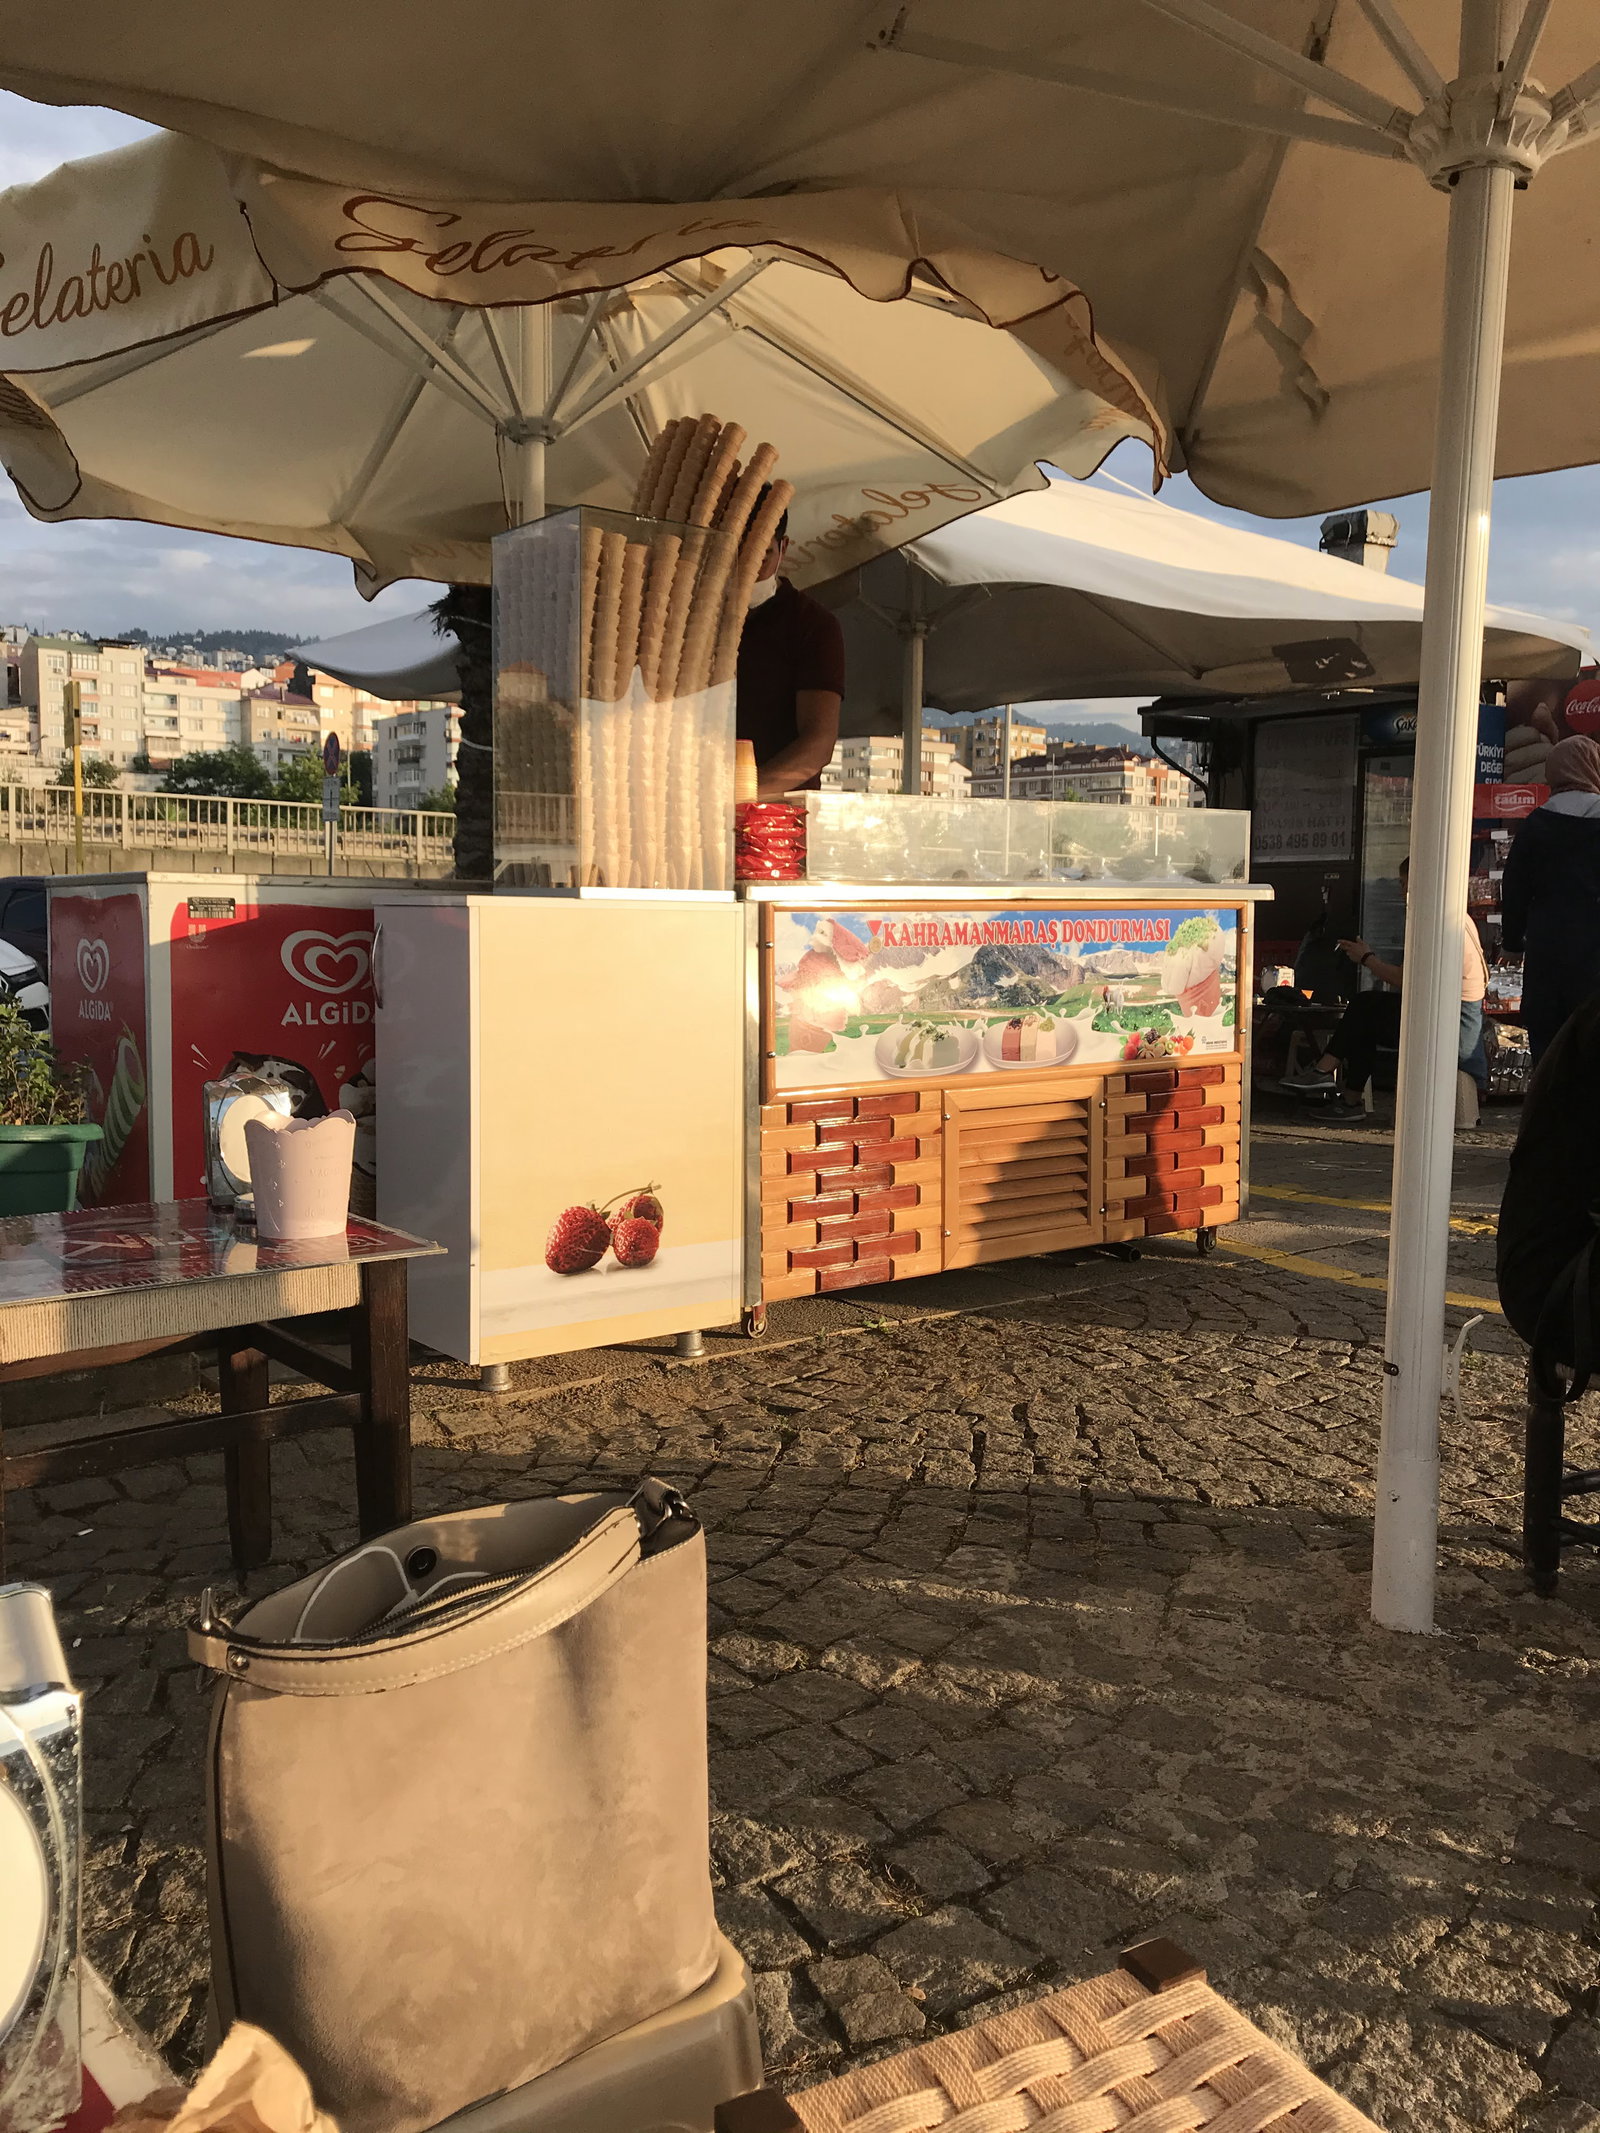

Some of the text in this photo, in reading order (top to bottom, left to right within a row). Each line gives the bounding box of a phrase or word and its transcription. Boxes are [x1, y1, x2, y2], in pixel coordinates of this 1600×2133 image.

[0, 231, 215, 337] elateria
[1254, 831, 1345, 850] 0538 495 89 01
[883, 918, 1171, 949] KAHRAMANMARAŞ DONDURMASI
[280, 1001, 375, 1026] ALGiD
